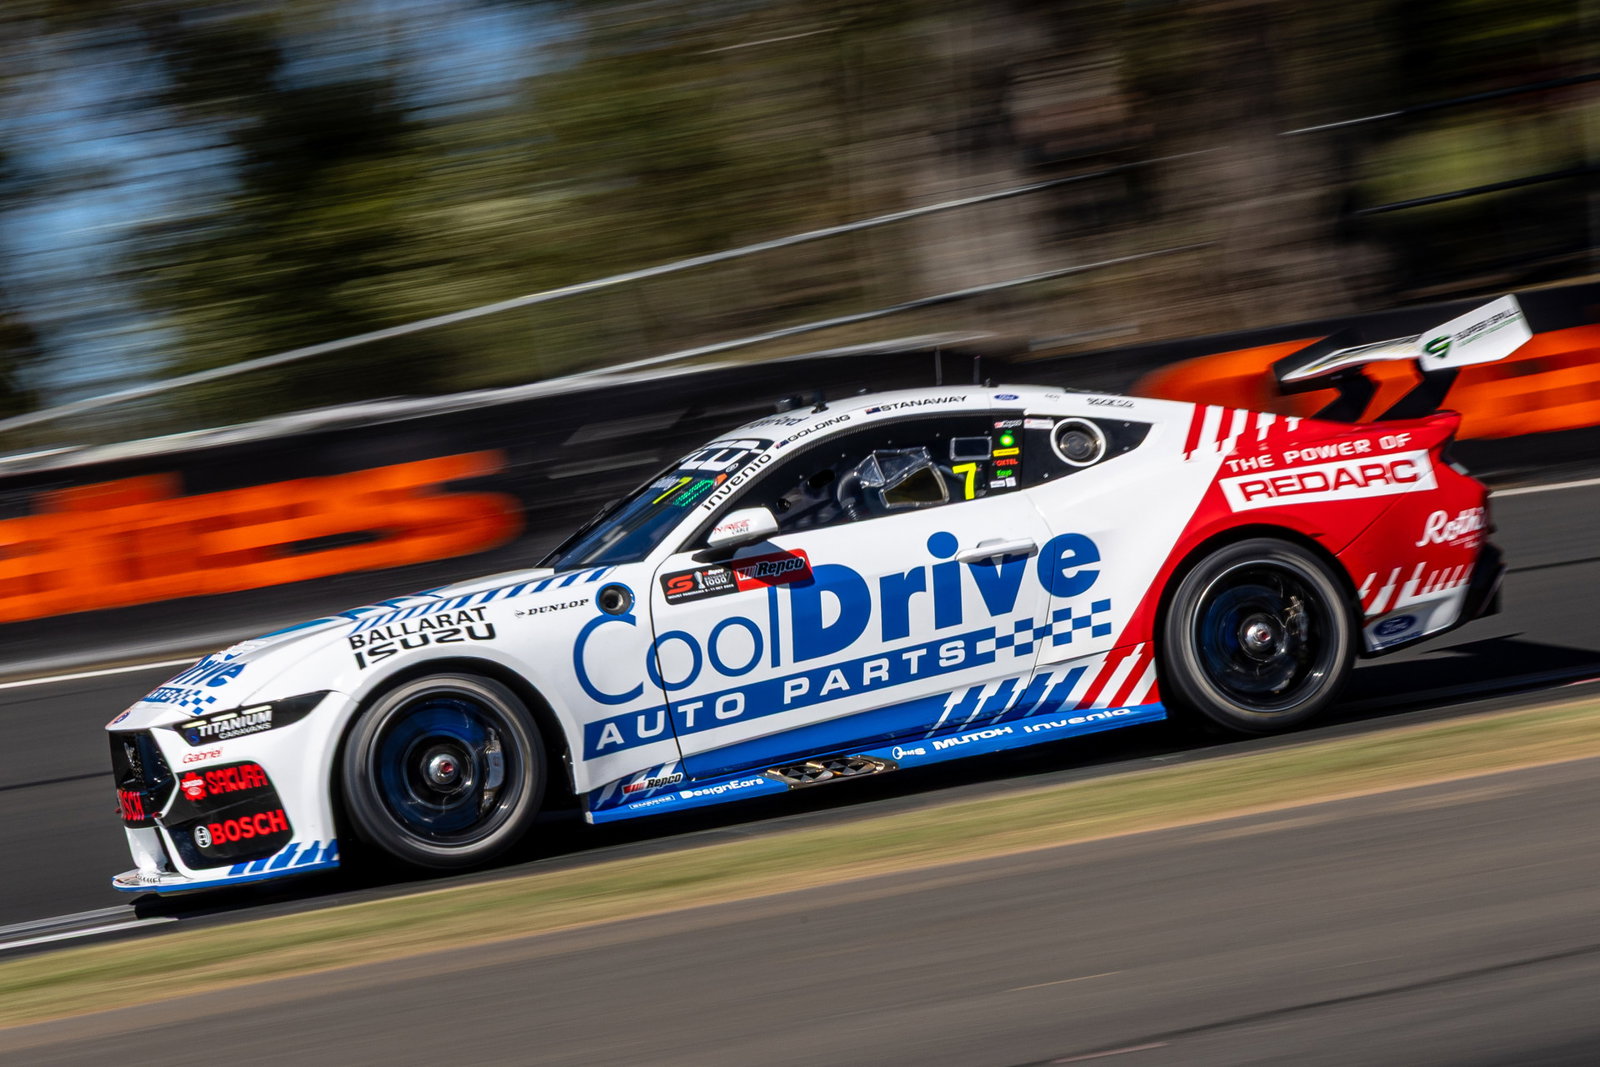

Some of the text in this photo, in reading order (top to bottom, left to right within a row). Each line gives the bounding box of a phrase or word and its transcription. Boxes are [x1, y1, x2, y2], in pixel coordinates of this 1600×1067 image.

[880, 395, 967, 411] STANAWAY
[788, 414, 851, 442] GOLDING
[1225, 432, 1413, 472] THE POWER OF
[702, 454, 772, 511] invenio
[952, 462, 976, 500] 7
[1238, 459, 1420, 501] REDARC
[757, 557, 805, 577] Repco
[705, 577, 726, 587] 1000
[528, 598, 589, 616] DUNLOP
[348, 606, 487, 651] BALLARAT
[354, 622, 496, 671] ISUZU
[596, 640, 966, 751] AUTO PARTS
[198, 710, 272, 737] TITANIUM
[219, 722, 272, 740] CARAVANS
[933, 709, 1132, 750] MUTOH invenio
[182, 746, 224, 764] Gabriel
[205, 764, 269, 795] SAKURA
[646, 774, 682, 790] Repco
[680, 778, 764, 799] DesignEars
[208, 809, 288, 845] BOSCH
